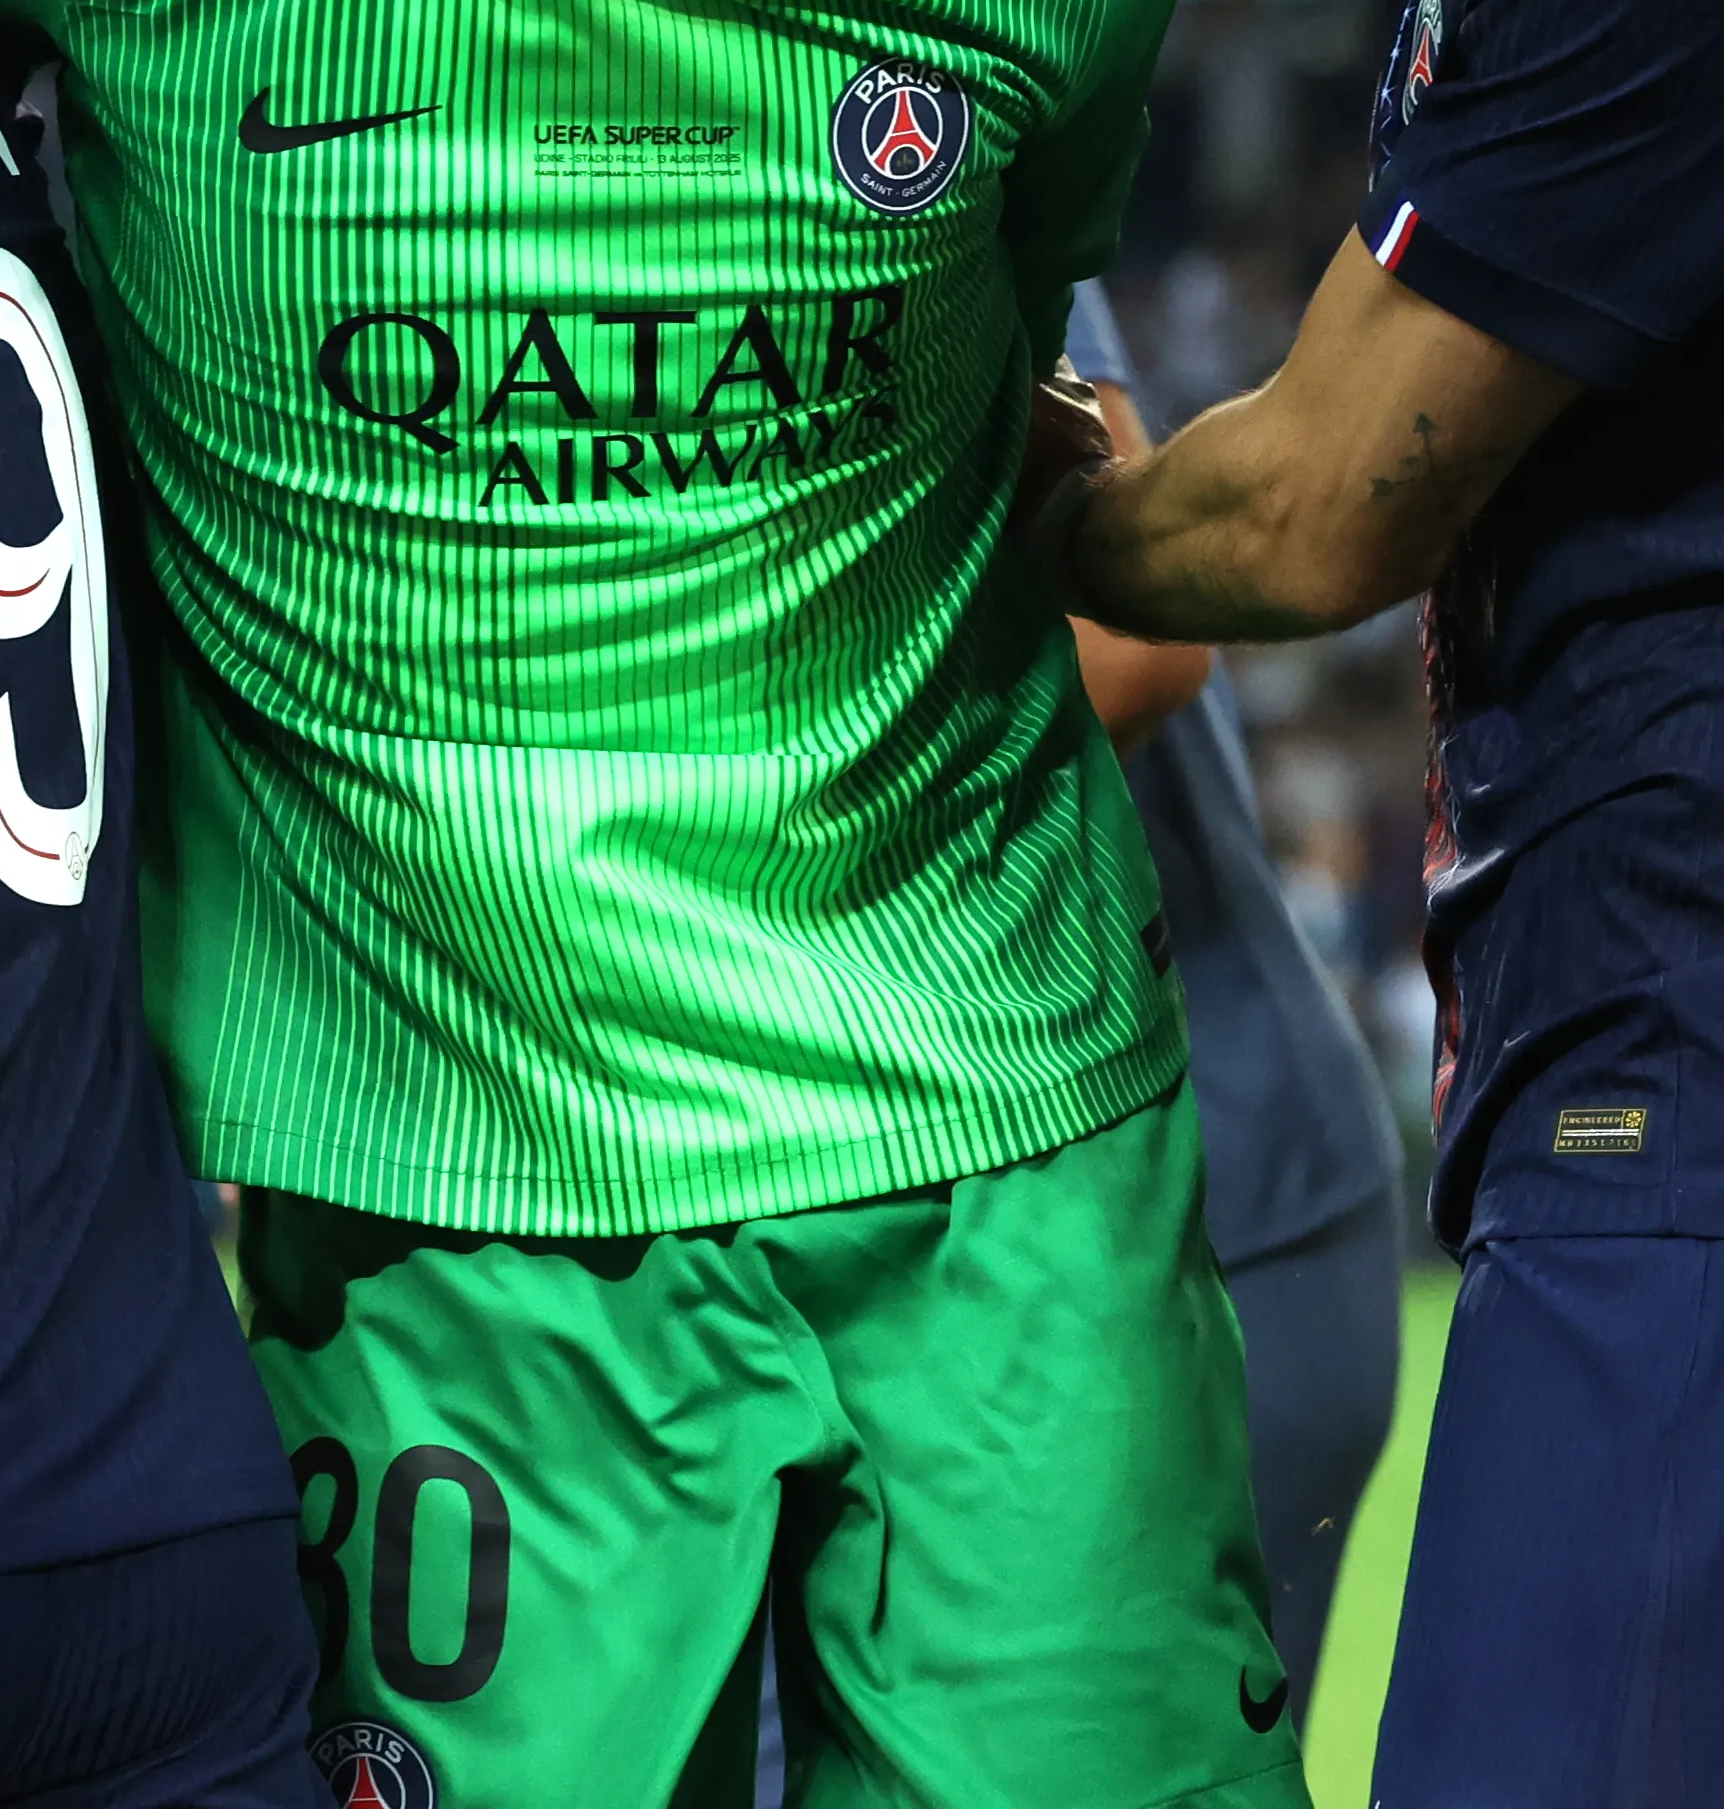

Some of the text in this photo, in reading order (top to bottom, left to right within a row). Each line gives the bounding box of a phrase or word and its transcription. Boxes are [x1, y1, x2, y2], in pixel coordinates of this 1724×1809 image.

[854, 62, 945, 105] PARIS
[533, 125, 598, 145] UEFA
[604, 125, 683, 146] SUPER
[574, 153, 614, 164] STADIO
[670, 154, 712, 164] AUGUST
[714, 153, 742, 163] 2025
[860, 160, 948, 197] SAINT GERMAIN
[317, 286, 903, 454] QATAR
[318, 1728, 405, 1766] PARIS
